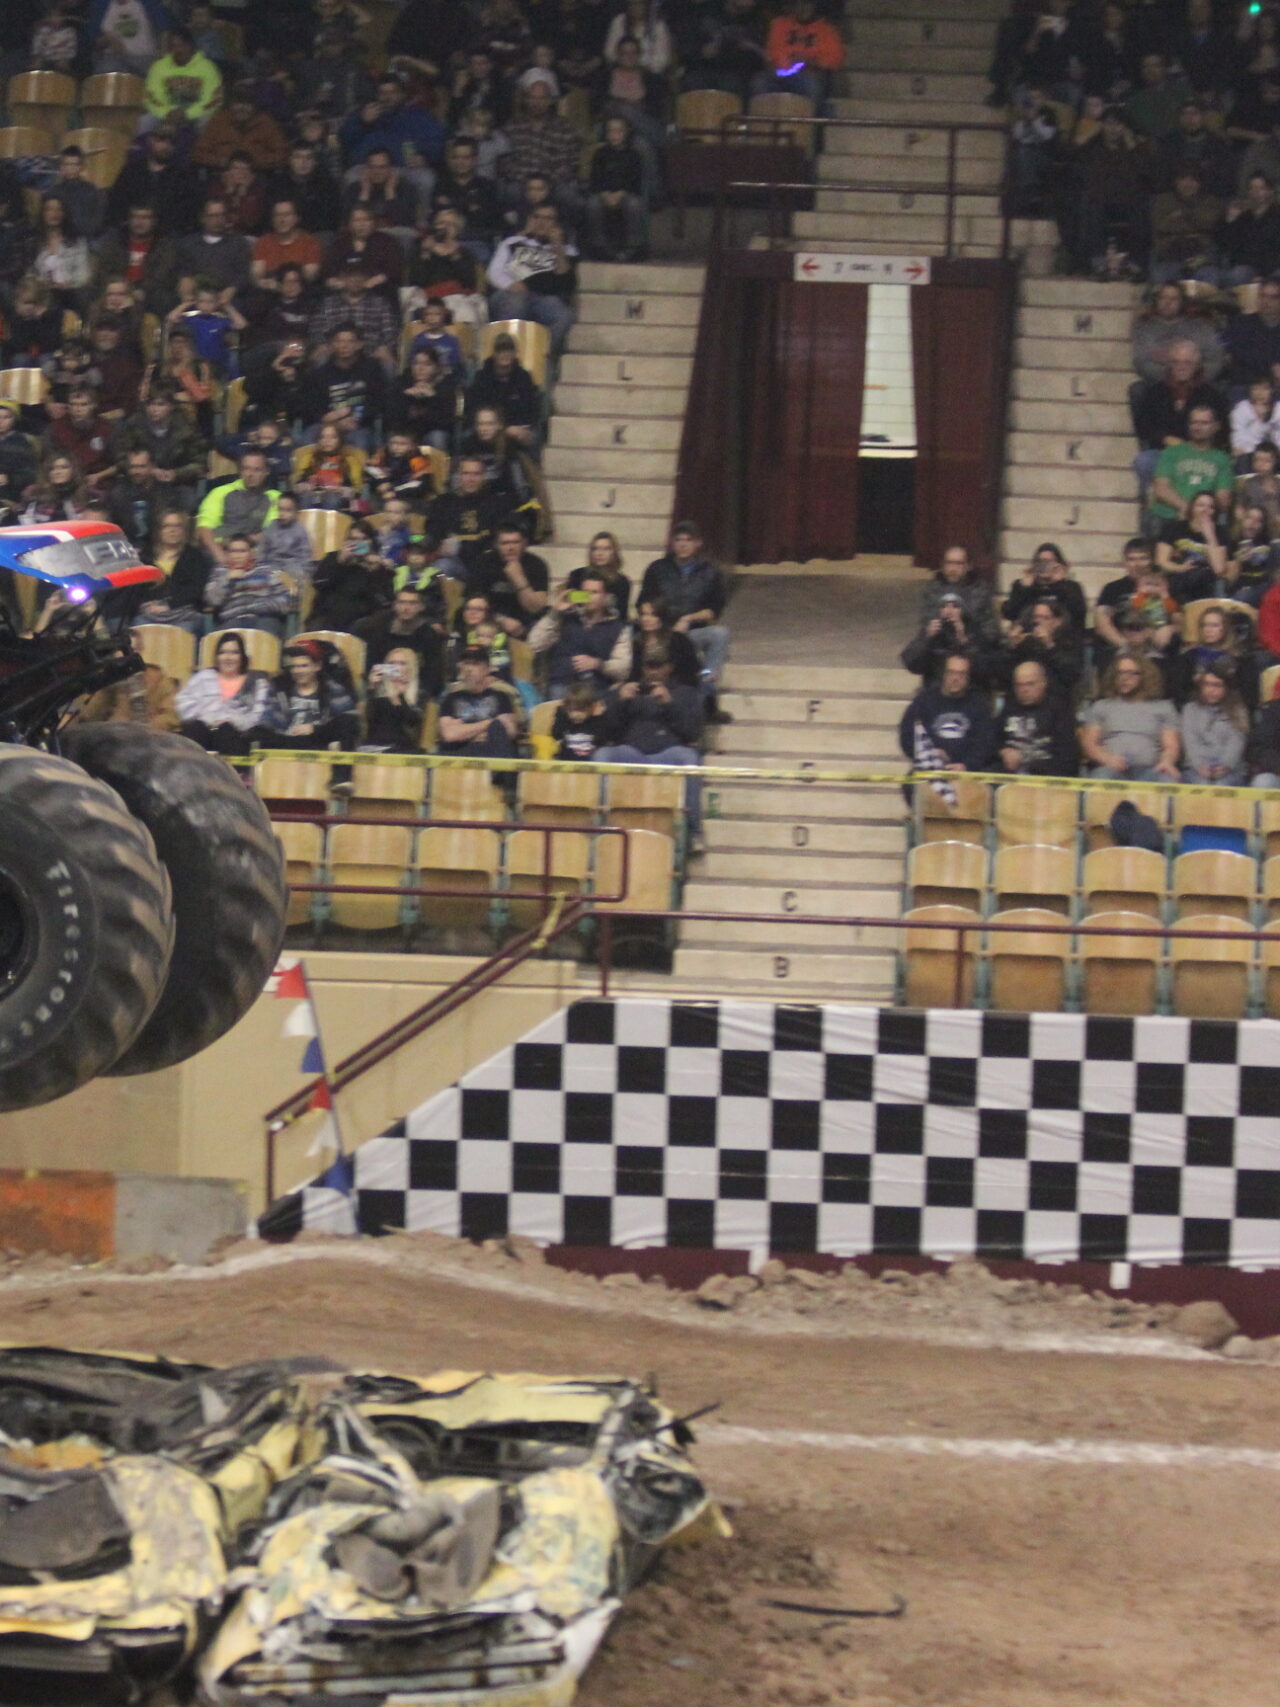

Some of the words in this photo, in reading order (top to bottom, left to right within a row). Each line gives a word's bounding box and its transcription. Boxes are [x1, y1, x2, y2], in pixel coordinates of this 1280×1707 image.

[617, 360, 633, 382] L
[1072, 376, 1087, 398] L
[613, 424, 629, 445] K
[1066, 440, 1083, 461] K
[602, 487, 617, 508] J
[1064, 505, 1081, 526] J
[806, 699, 823, 722] F
[791, 825, 808, 847] D
[782, 890, 798, 912] C
[773, 955, 790, 979] B
